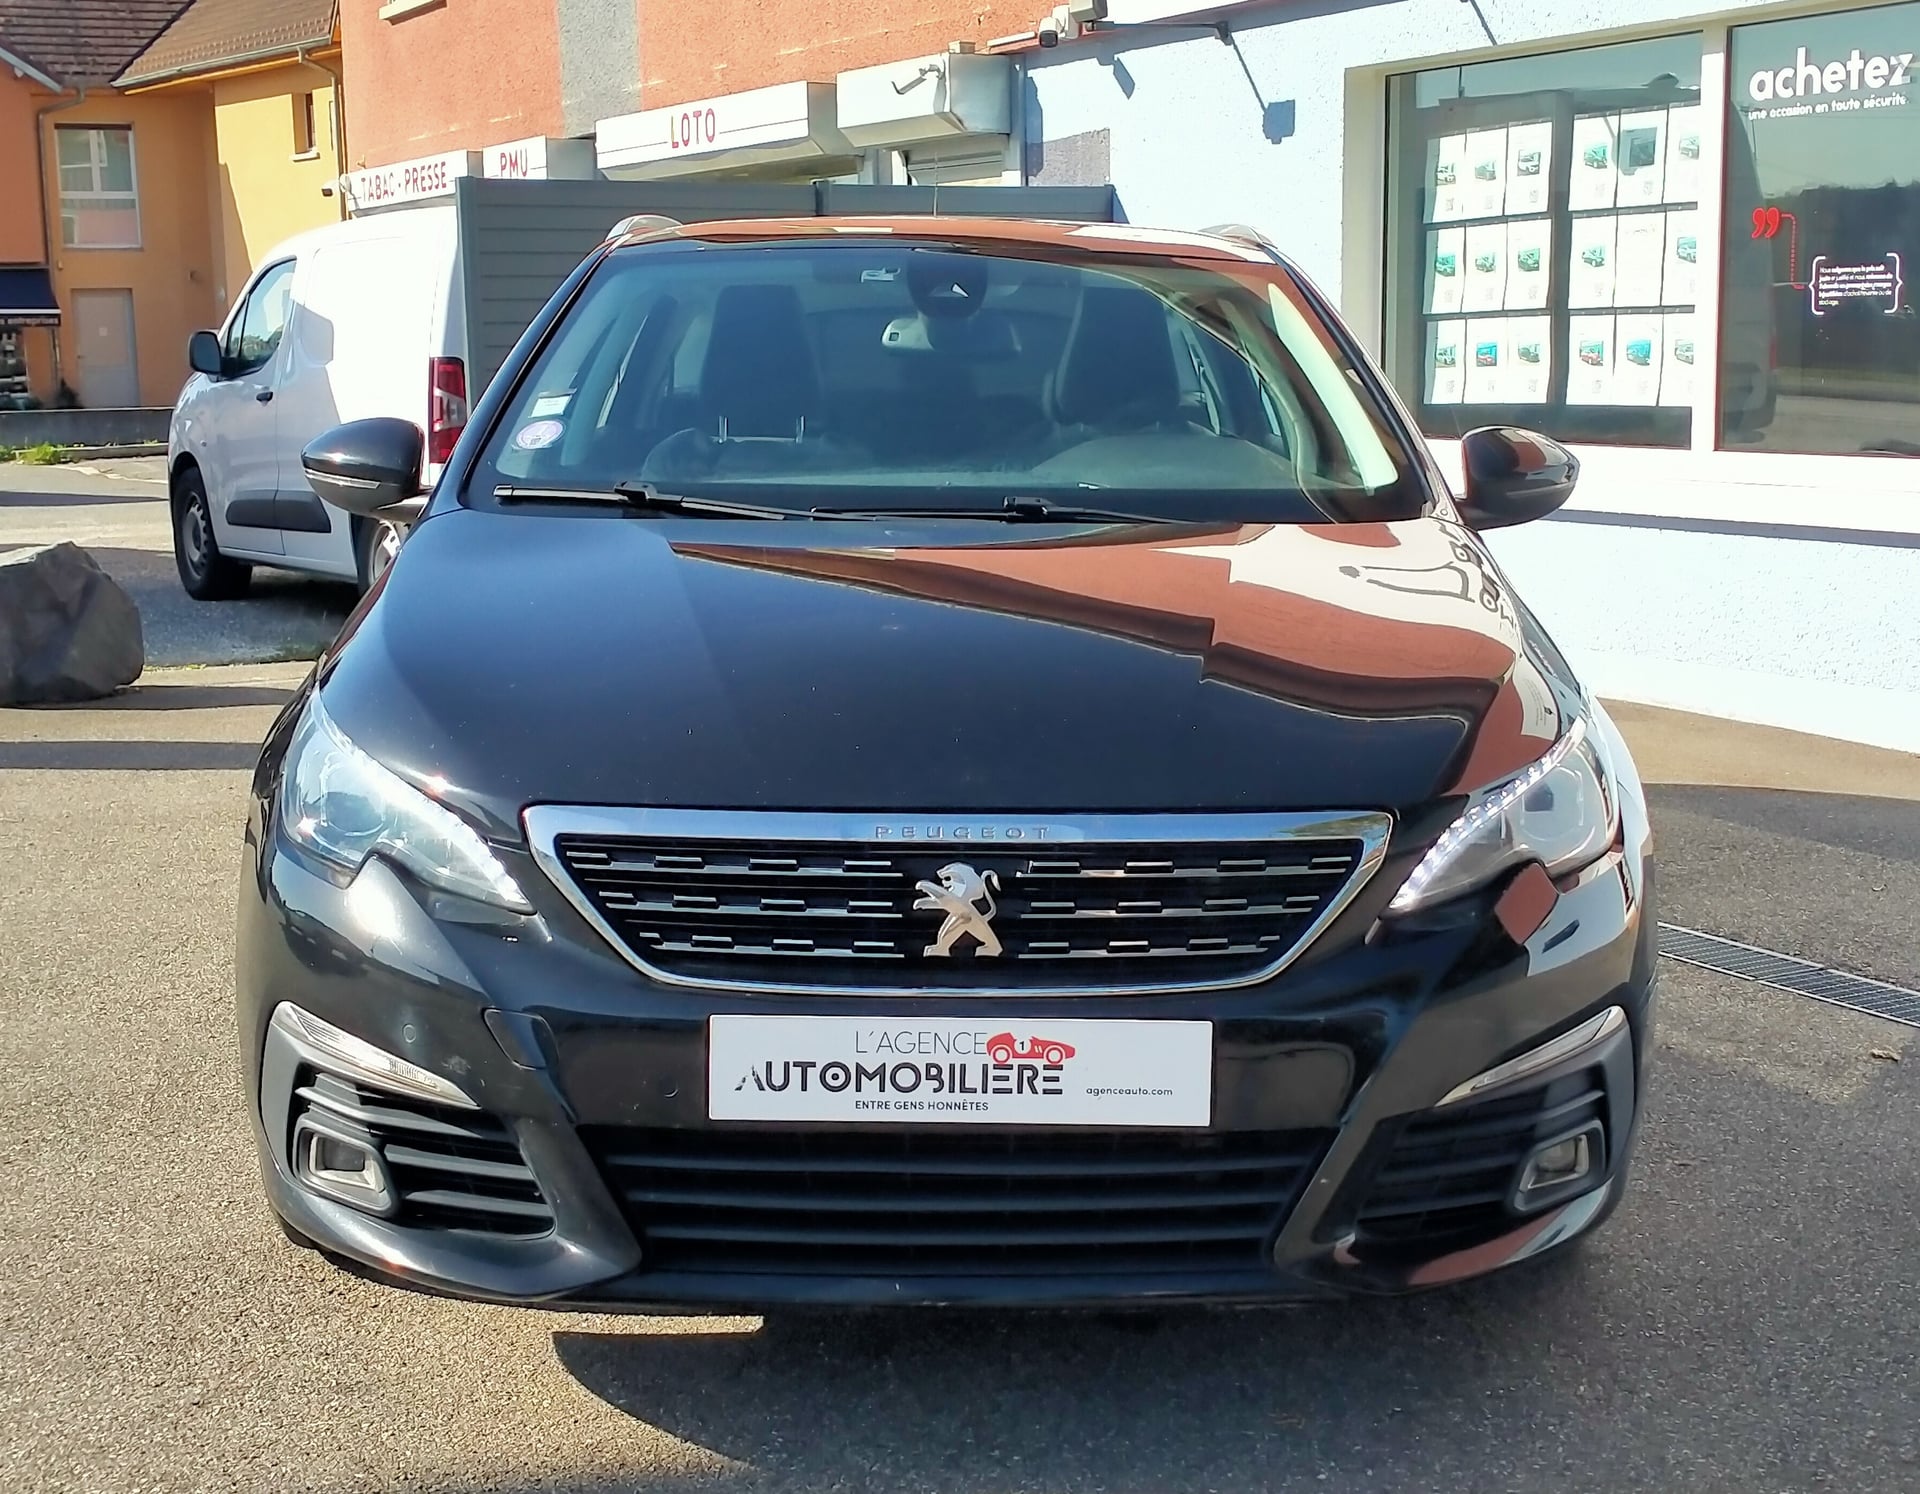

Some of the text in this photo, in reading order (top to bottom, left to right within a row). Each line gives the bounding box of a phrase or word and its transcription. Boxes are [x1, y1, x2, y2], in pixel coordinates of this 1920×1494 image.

[1749, 46, 1914, 102] achetez
[1748, 109, 1768, 121] une
[1769, 102, 1813, 118] occasion
[1815, 103, 1829, 114] en
[1831, 98, 1860, 112] toute
[671, 108, 716, 149] LOTO
[499, 148, 528, 178] PMU
[360, 171, 396, 203] TABAC
[404, 161, 447, 195] PRESSE
[875, 825, 1050, 839] PEUGEOT
[855, 1031, 988, 1056] L'AGENCE
[1019, 1041, 1026, 1051] 1
[1086, 1087, 1173, 1097] agenceauto.com
[855, 1098, 989, 1112] ENTRE GENS HONNÊTES
